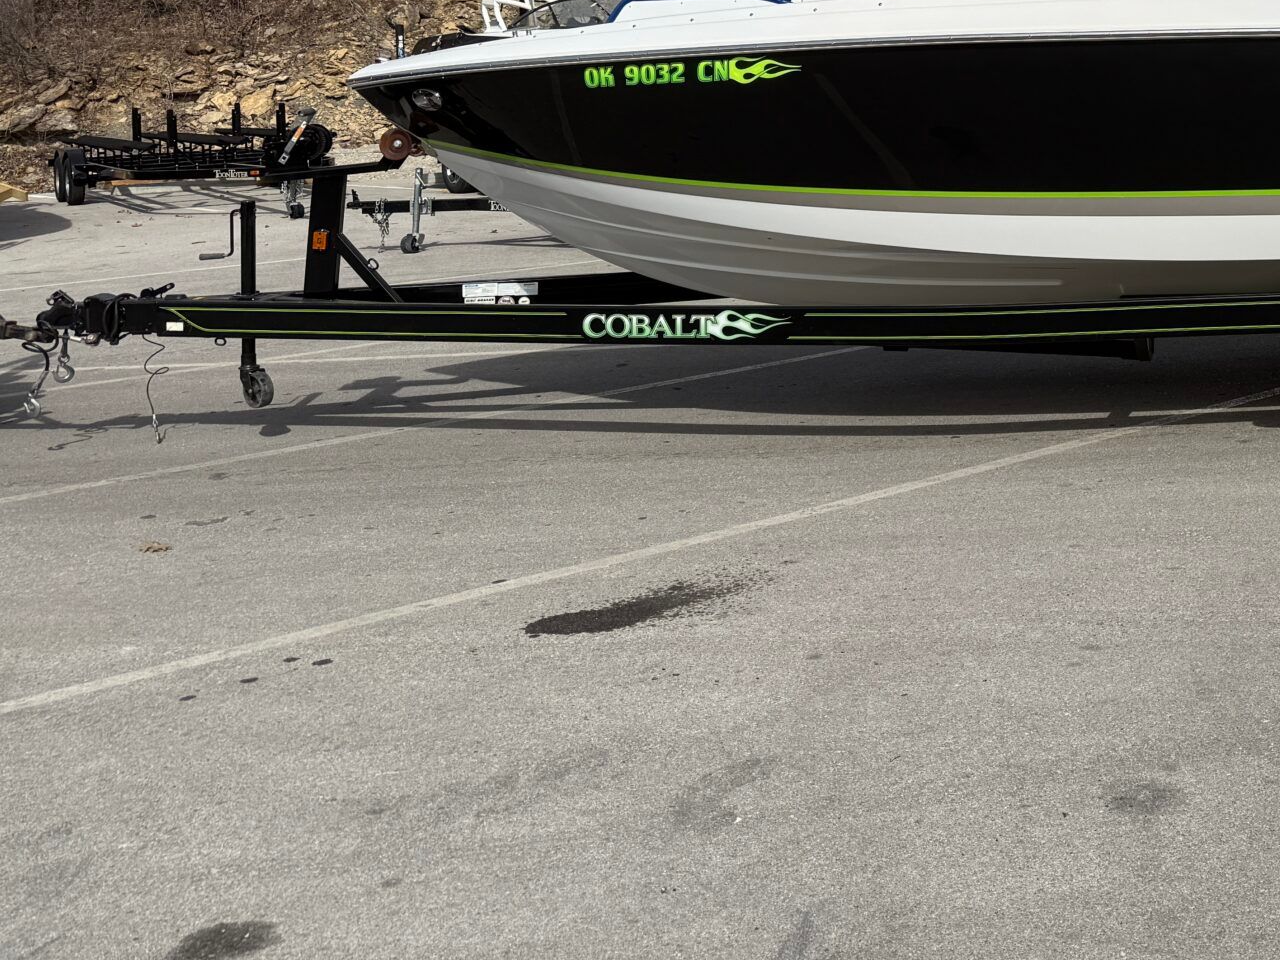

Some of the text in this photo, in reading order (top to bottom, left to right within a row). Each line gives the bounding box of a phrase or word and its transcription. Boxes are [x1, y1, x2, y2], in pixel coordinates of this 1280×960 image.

[584, 59, 729, 88] OK 9032 CN
[582, 312, 717, 339] COBALT
